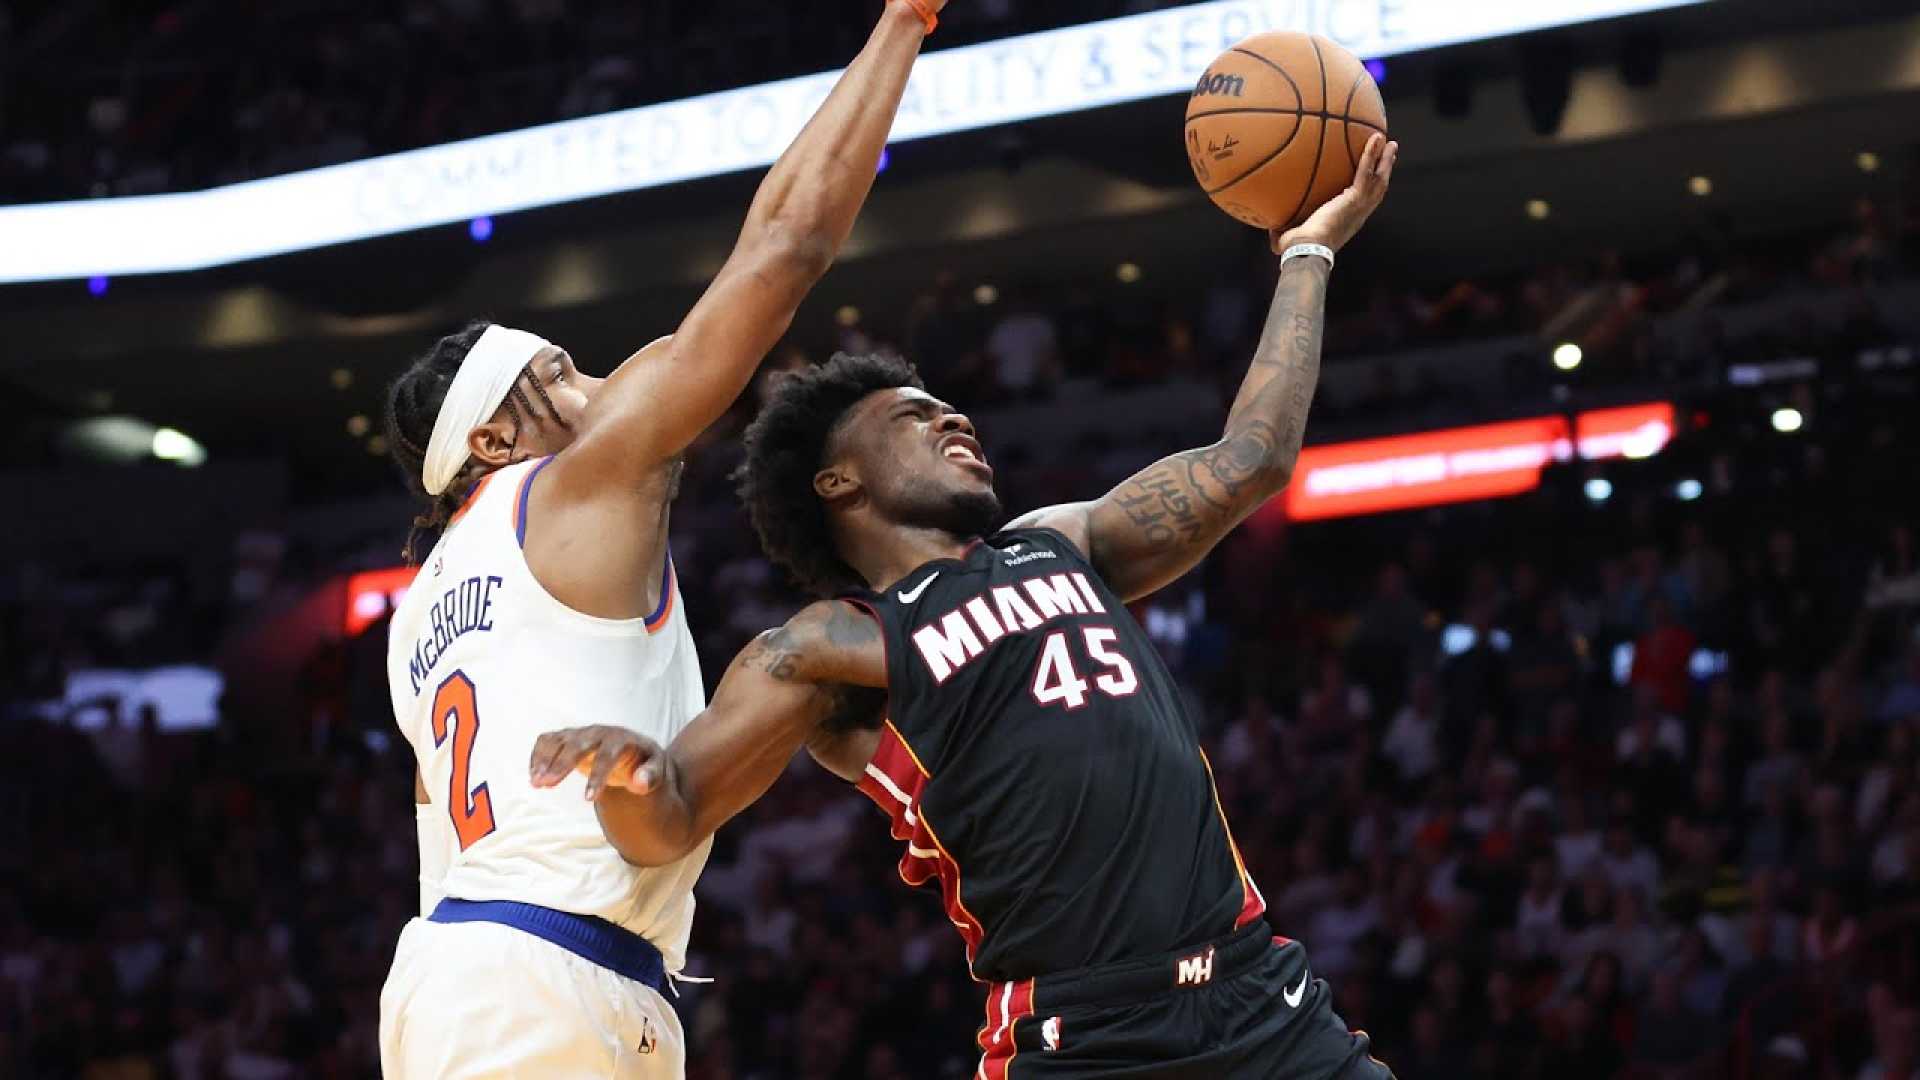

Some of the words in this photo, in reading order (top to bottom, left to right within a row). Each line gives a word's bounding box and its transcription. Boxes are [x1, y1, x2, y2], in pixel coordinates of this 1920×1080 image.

[408, 575, 503, 697] McBRIDE
[911, 571, 1107, 685] MIAMI
[1031, 625, 1139, 710] 45
[431, 668, 497, 853] 2
